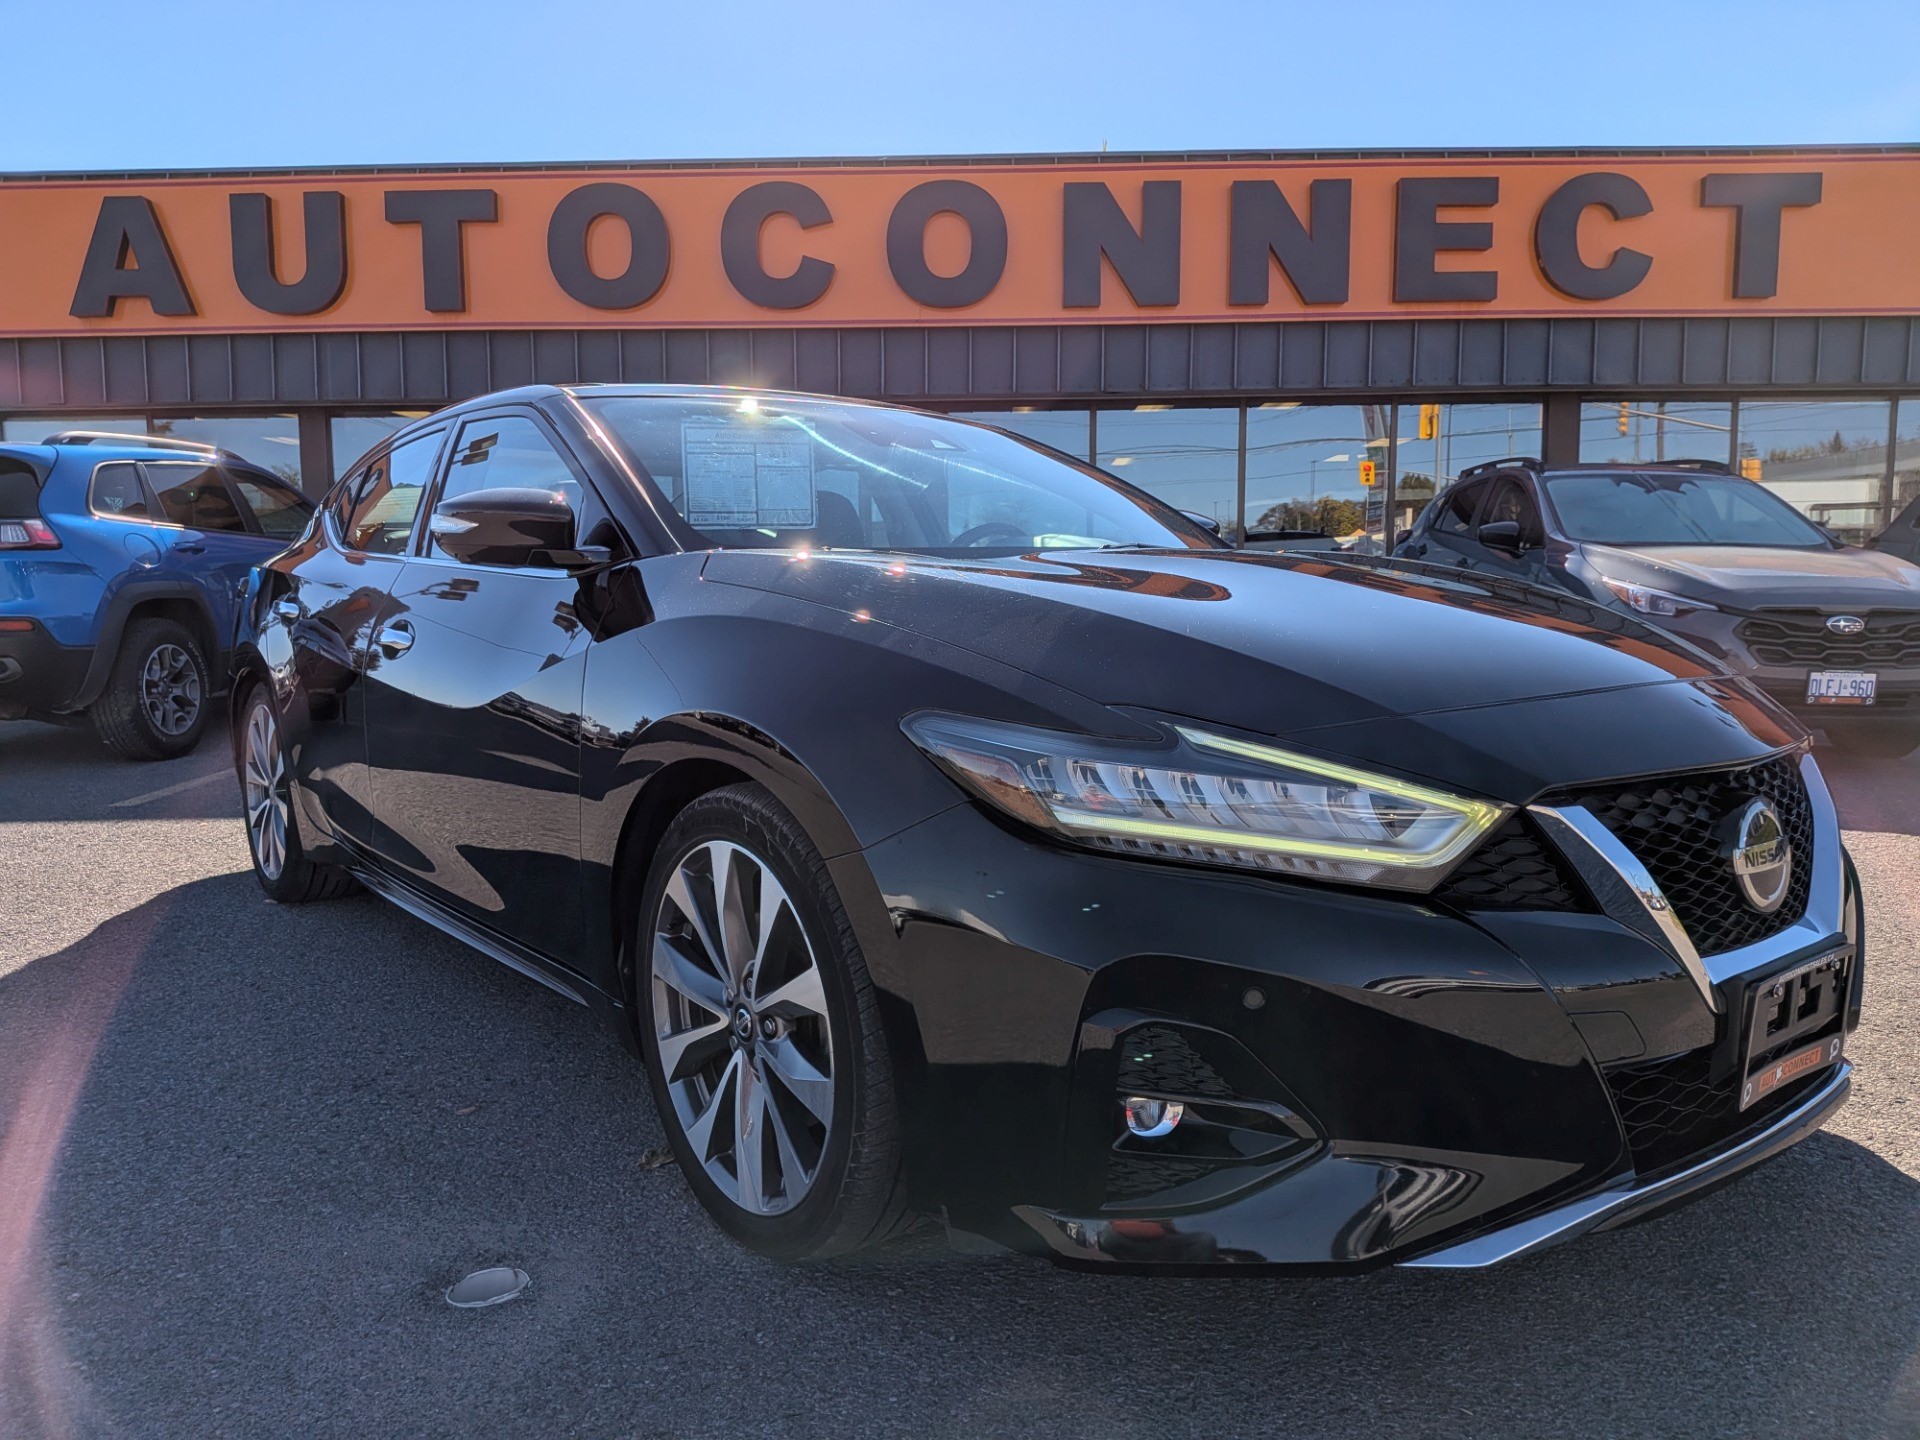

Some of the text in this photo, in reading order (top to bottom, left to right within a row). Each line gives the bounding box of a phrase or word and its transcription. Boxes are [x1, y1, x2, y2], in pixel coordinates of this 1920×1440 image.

[69, 172, 1823, 318] AUTOCONNECT
[1849, 679, 1874, 697] 960
[1744, 842, 1786, 869] NISSAN
